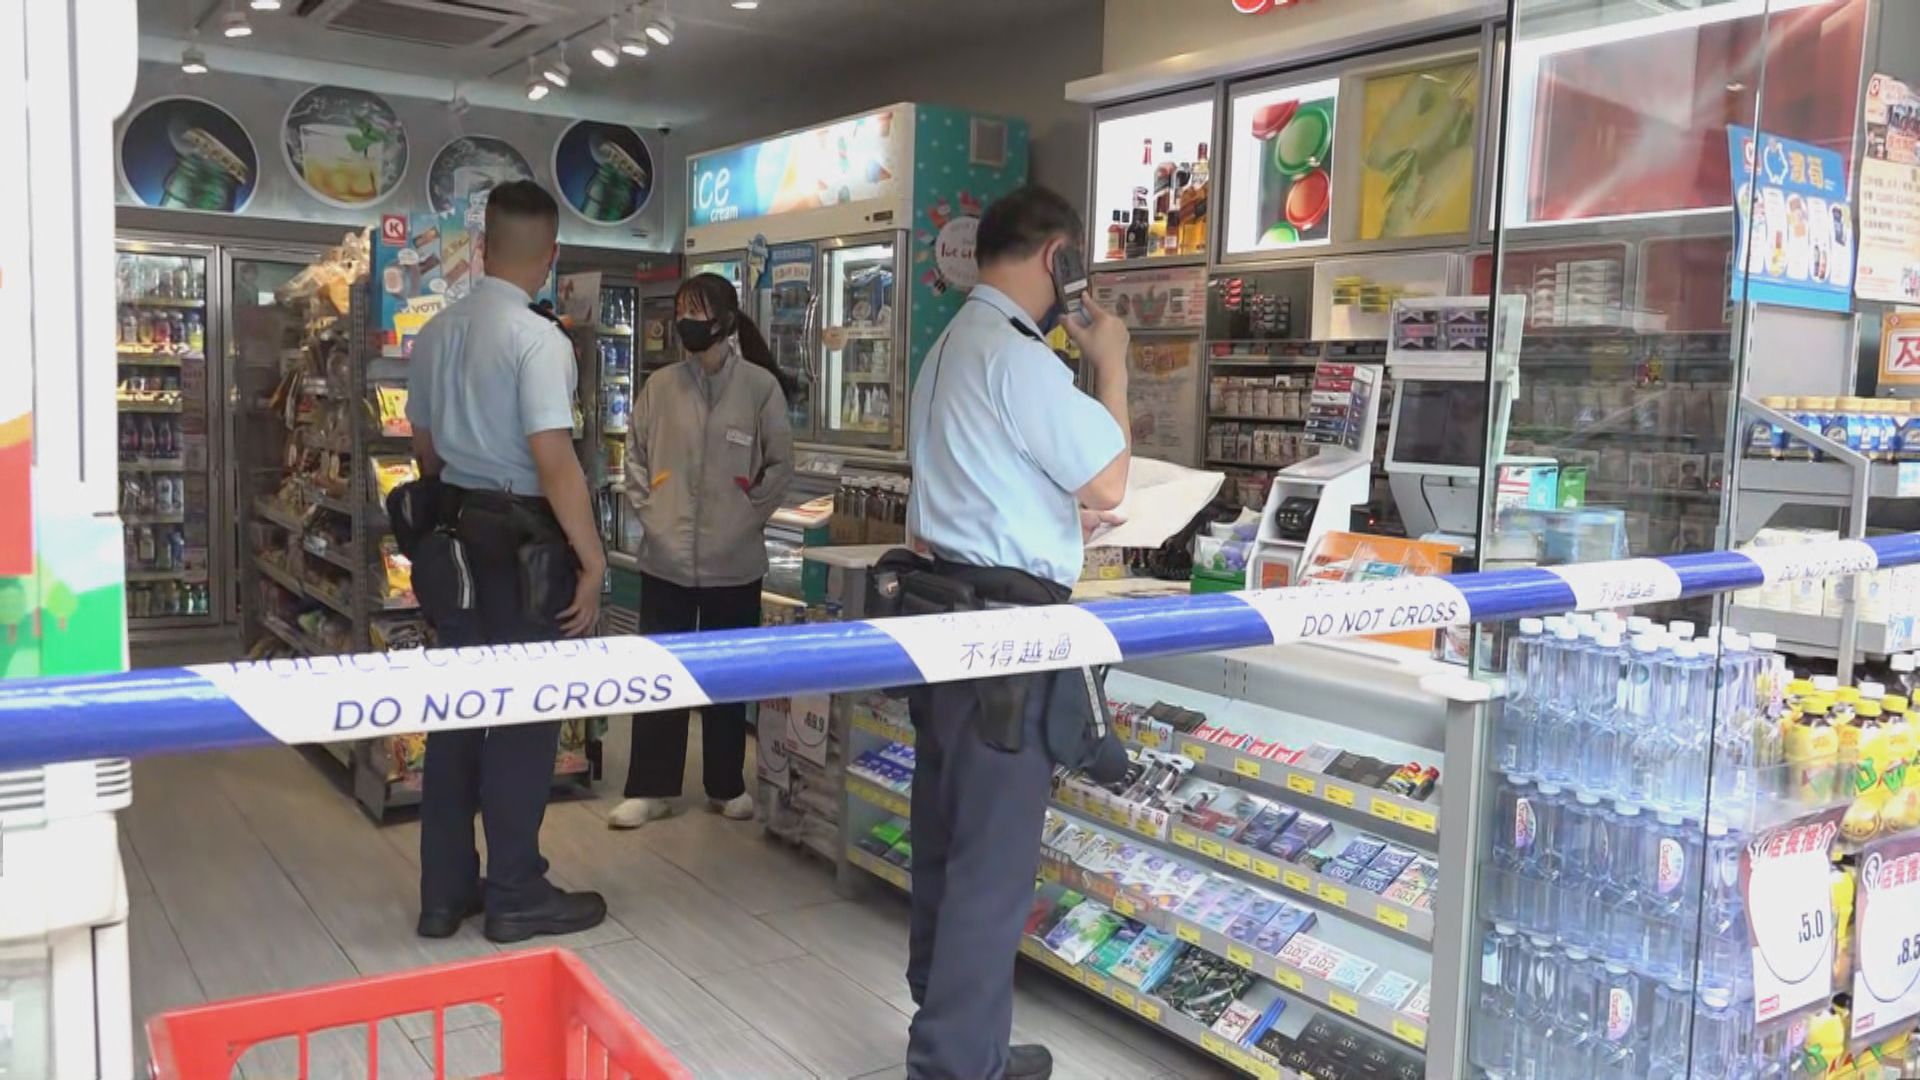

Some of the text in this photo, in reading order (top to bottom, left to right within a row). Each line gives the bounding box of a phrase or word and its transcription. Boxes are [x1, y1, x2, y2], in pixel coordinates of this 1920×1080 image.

[693, 161, 731, 211] ice
[710, 205, 739, 222] cream
[1300, 601, 1458, 638] DO NOT CROSS
[959, 633, 1072, 670] 不得越過
[333, 674, 674, 731] DO NOT CROSS
